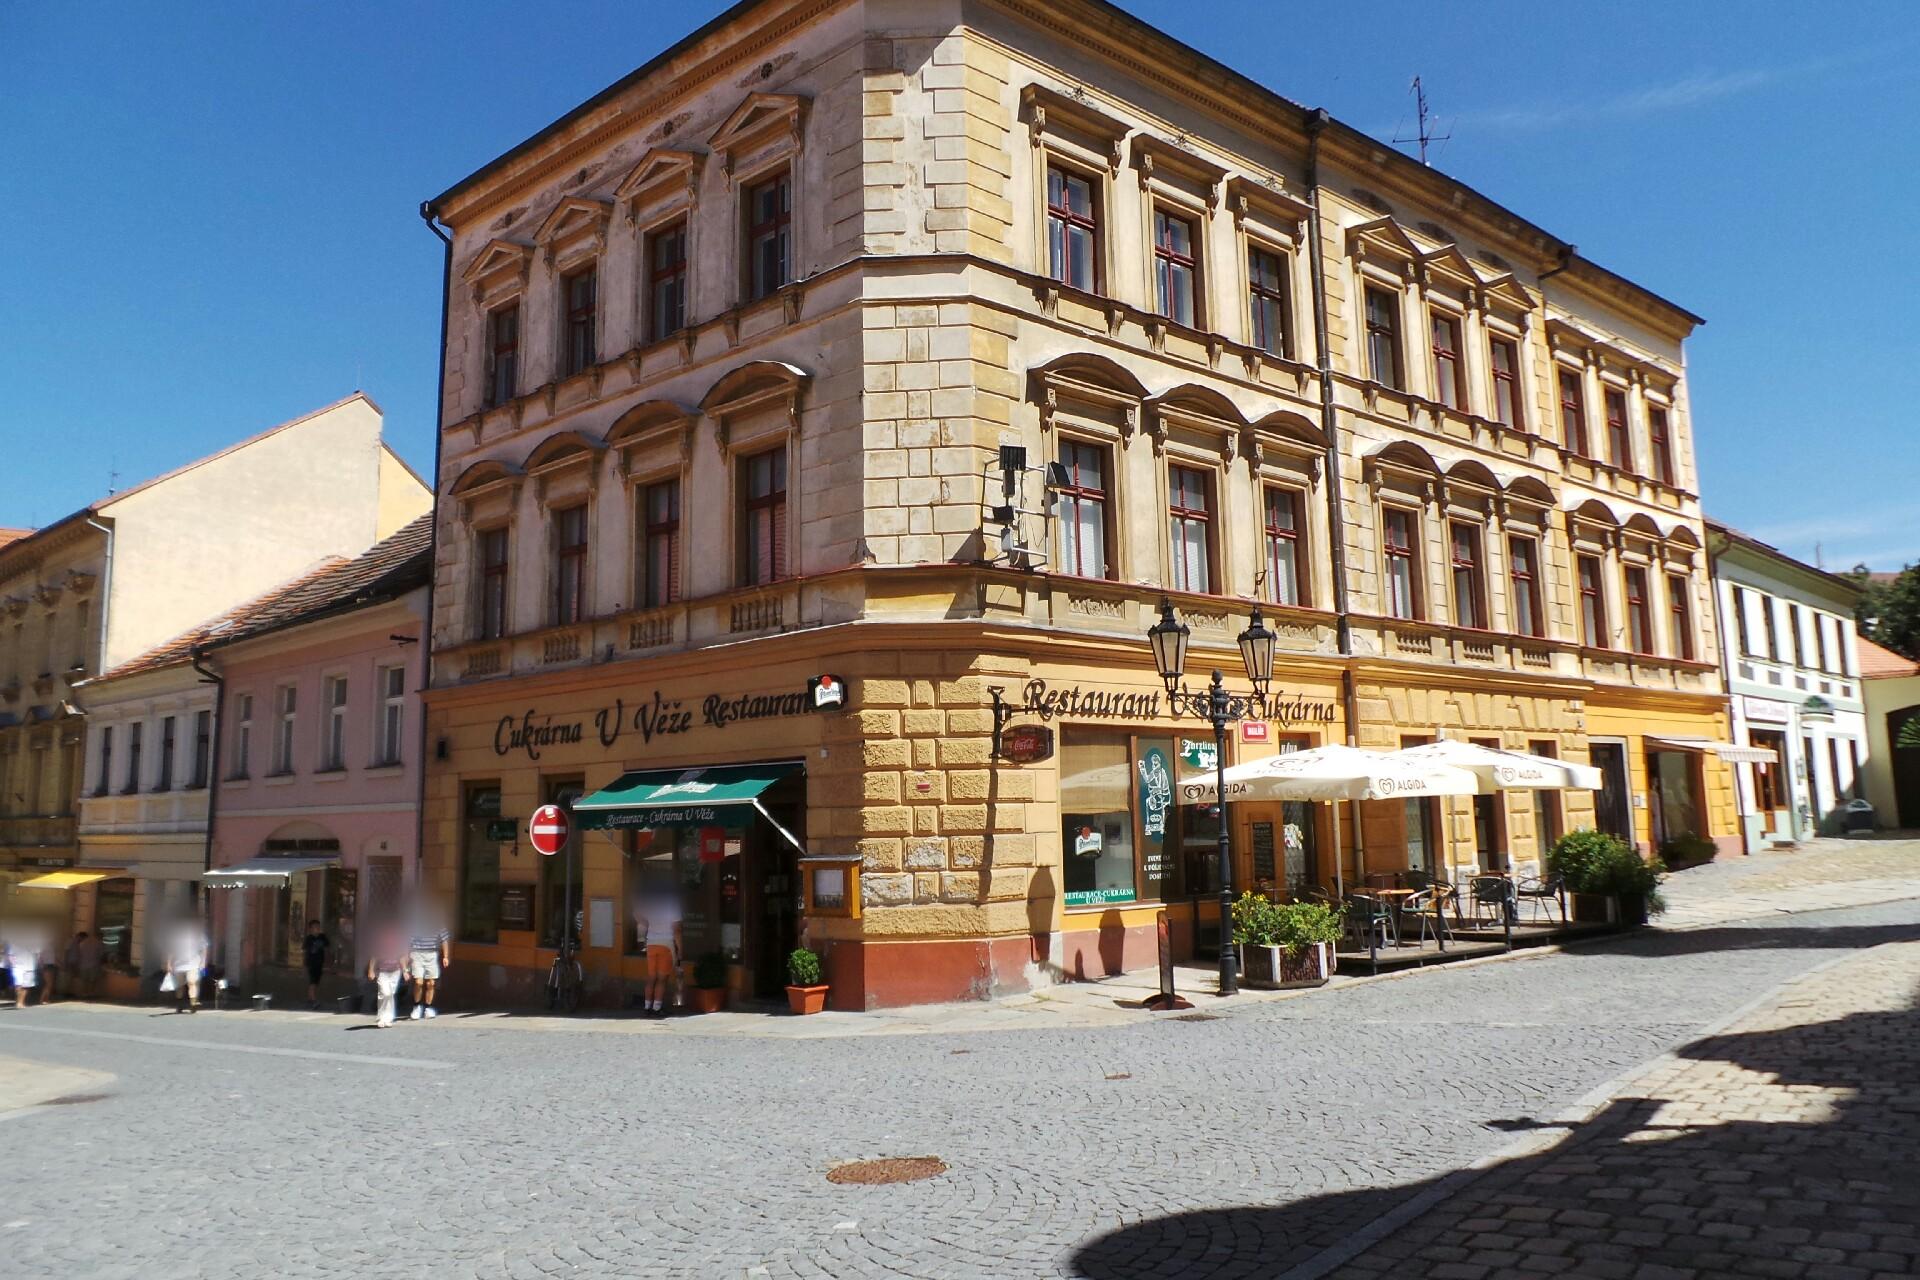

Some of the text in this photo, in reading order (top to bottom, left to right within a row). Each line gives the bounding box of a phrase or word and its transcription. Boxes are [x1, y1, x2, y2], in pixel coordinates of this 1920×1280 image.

[1024, 679, 1160, 721] Restaurant
[494, 690, 813, 760] Cukrárna U Věže Restauran
[1208, 783, 1247, 795] AGIDA
[1397, 780, 1427, 791] ALGIDA
[649, 809, 683, 825] Cukrárna
[685, 809, 694, 821] U
